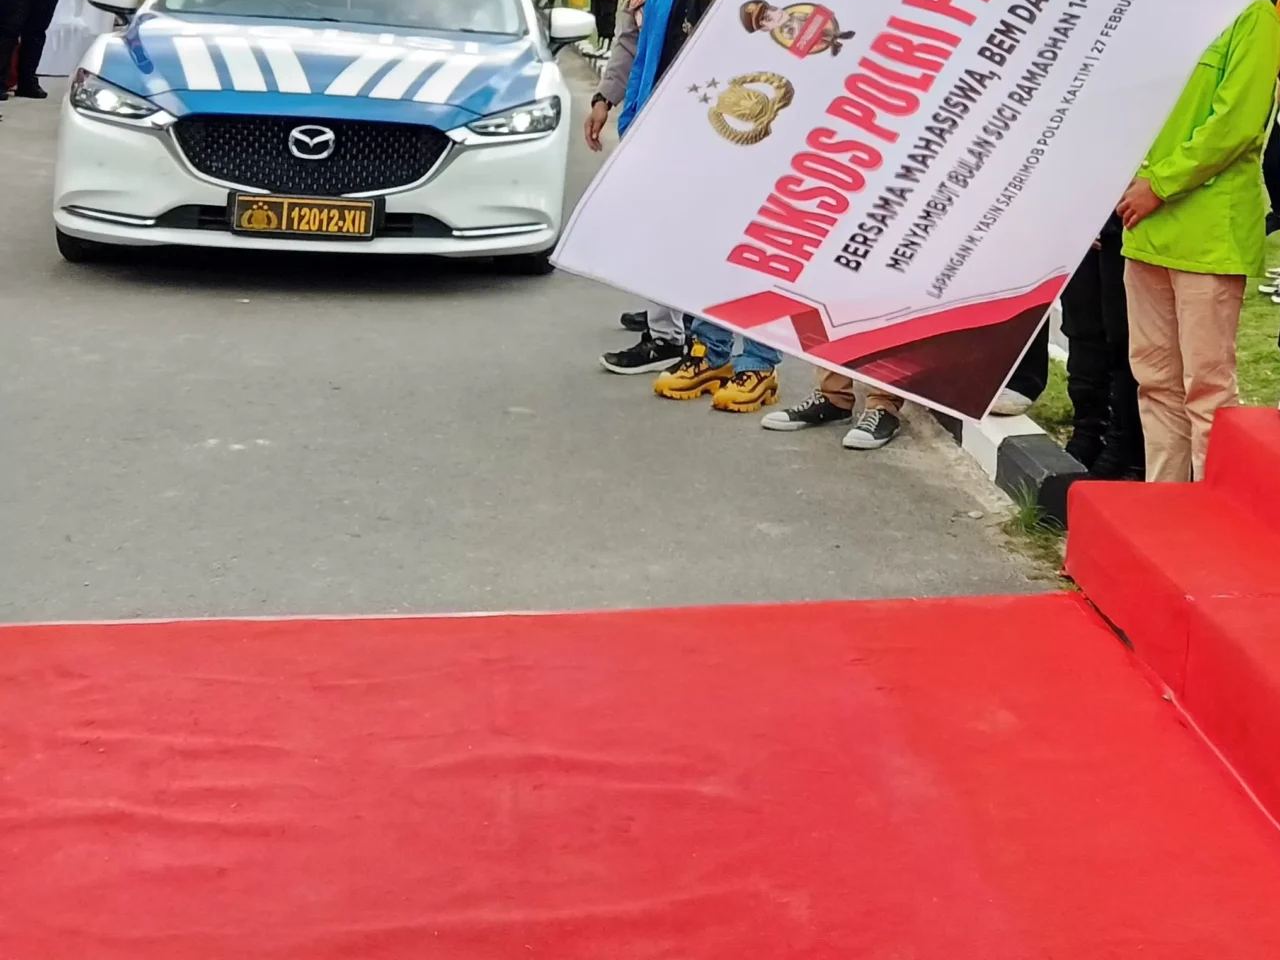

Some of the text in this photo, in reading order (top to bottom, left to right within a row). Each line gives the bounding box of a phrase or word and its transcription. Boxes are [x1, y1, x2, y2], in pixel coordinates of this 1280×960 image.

[1091, 39, 1107, 54] 27
[1060, 55, 1095, 105] KALTIM
[726, 127, 883, 283] BAKSOS
[826, 15, 962, 143] POLRI
[834, 186, 914, 273] BERSAMA
[894, 68, 1002, 183] MAHASISWA,
[977, 19, 1027, 67] BEM
[885, 181, 960, 274] MENYAMBUT
[947, 134, 997, 189] BULAN
[982, 103, 1022, 141] SUCI
[1007, 12, 1081, 107] RAMADHAN
[1036, 106, 1070, 148] POLDA
[996, 147, 1045, 208] SATBRIMOB
[291, 207, 366, 233] 12012-XII
[965, 234, 983, 248] M.
[973, 204, 1005, 233] YASIN
[926, 243, 975, 300] LAPANGAN
